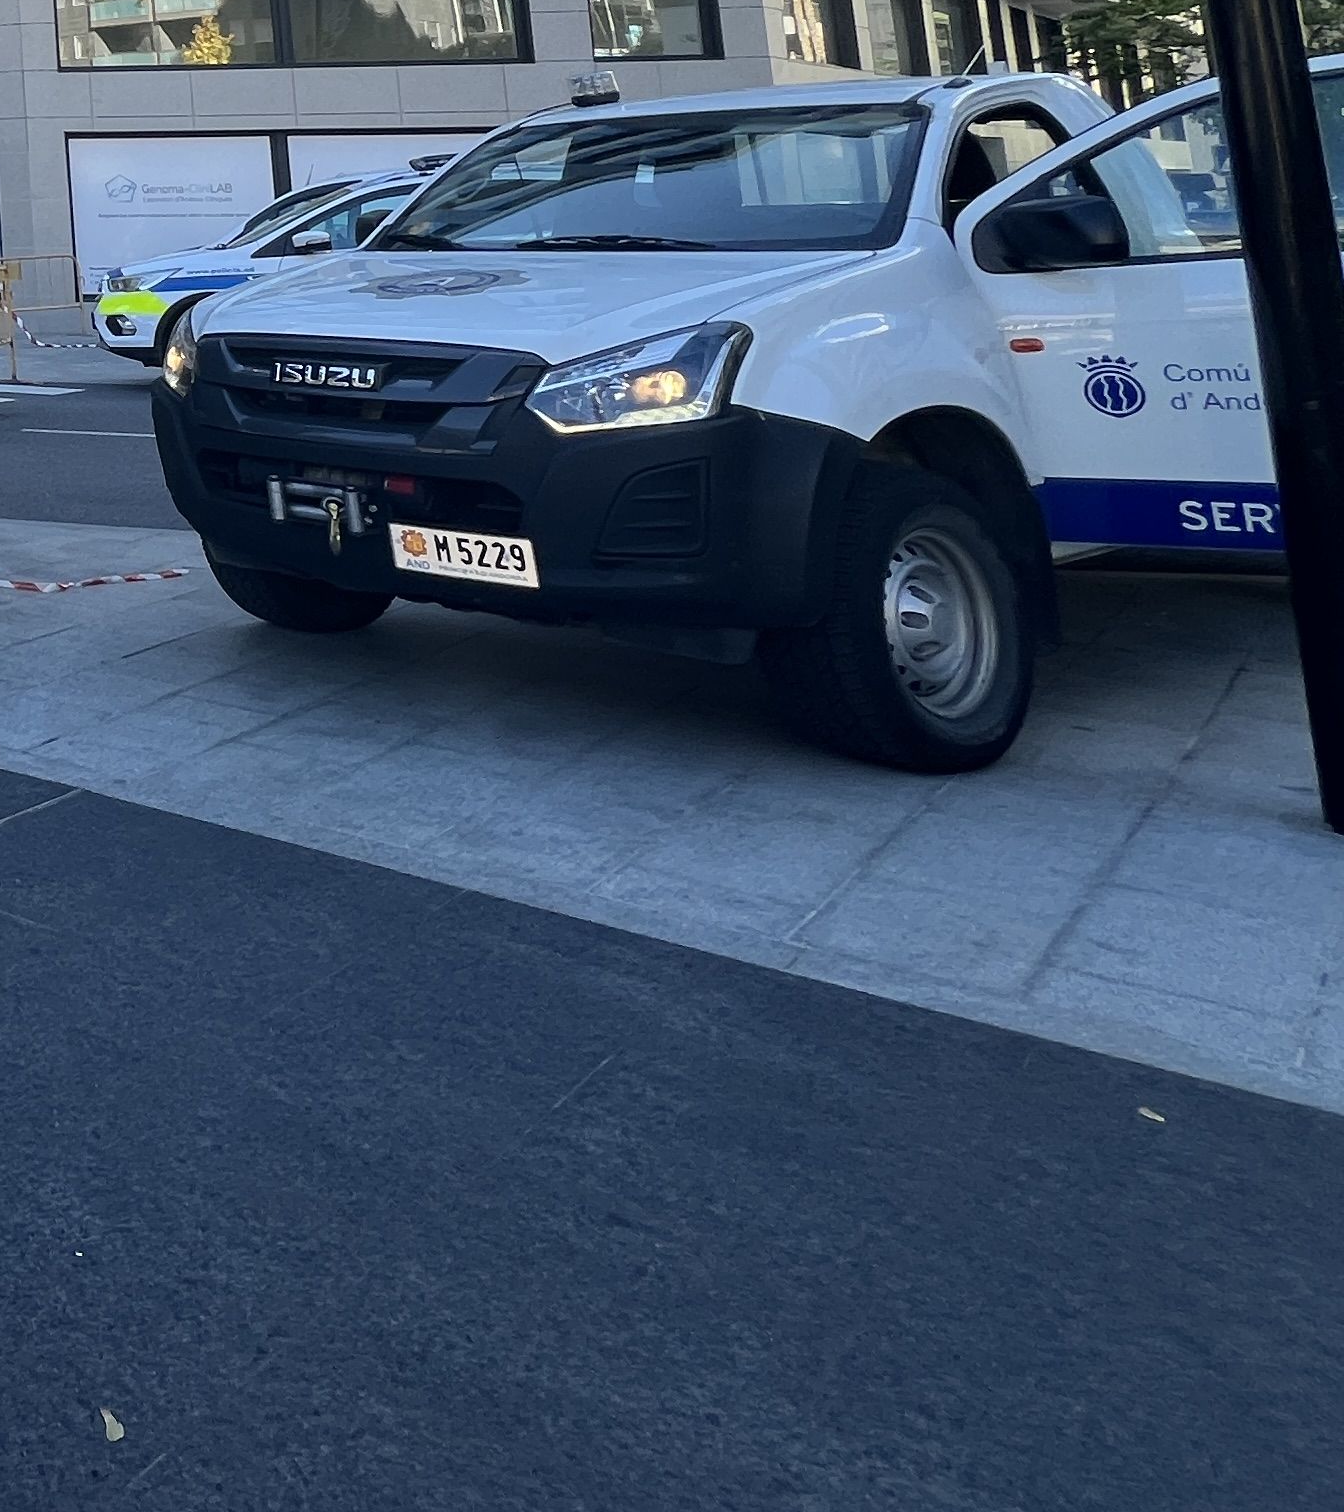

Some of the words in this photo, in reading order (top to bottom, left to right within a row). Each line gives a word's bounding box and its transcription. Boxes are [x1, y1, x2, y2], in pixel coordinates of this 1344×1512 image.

[274, 362, 376, 388] ISUZU
[1163, 363, 1251, 382] Comú
[1203, 392, 1265, 410] And
[1178, 500, 1281, 533] SER
[406, 558, 431, 570] AND
